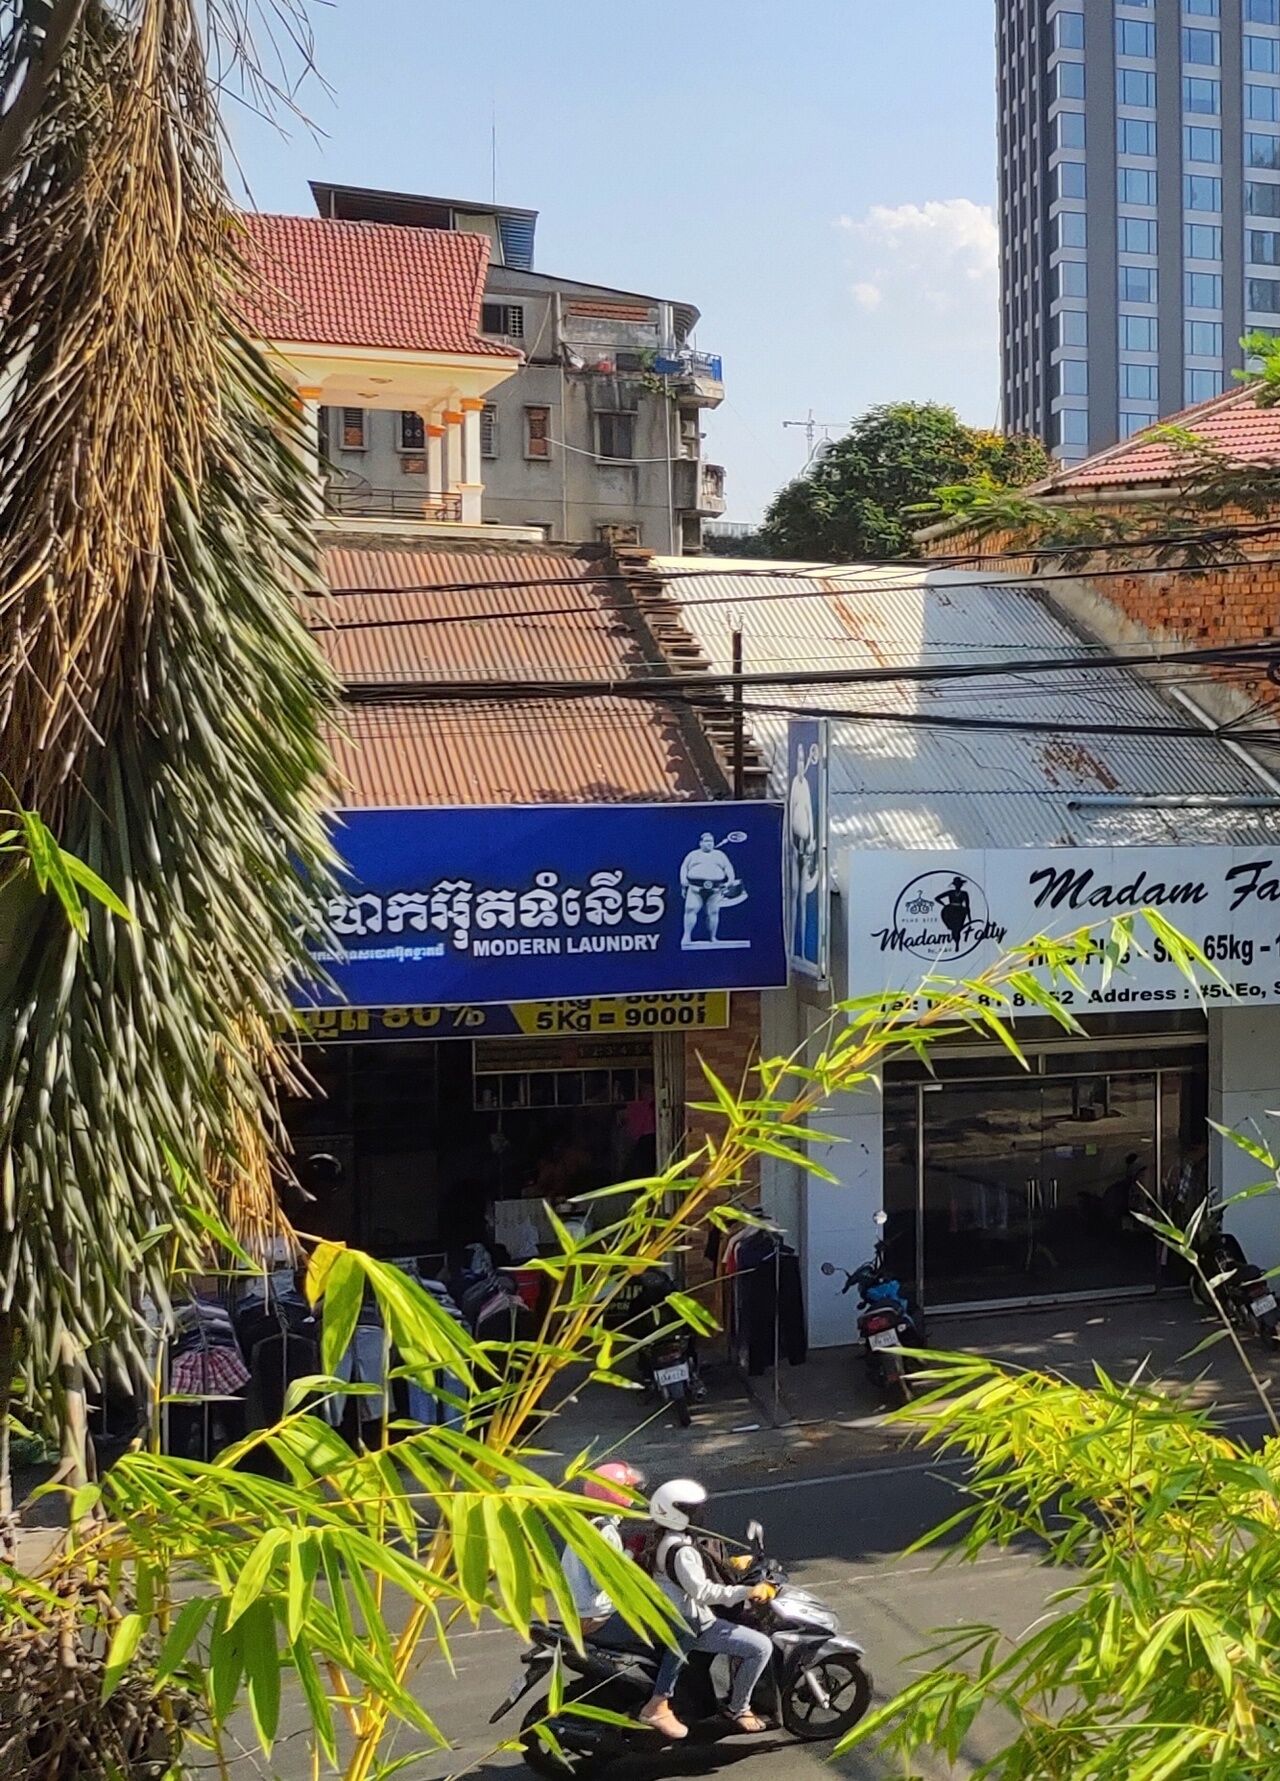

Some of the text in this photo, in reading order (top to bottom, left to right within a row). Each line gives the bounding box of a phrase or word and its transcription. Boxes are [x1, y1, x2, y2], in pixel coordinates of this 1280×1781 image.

[1029, 867, 1208, 909] Madam
[473, 934, 660, 958] MODERN LAUNDRY
[871, 919, 1007, 951] Madam Fatty
[1085, 938, 1131, 964] Pls
[1203, 933, 1254, 965] 65kg
[1088, 988, 1176, 1004] Address
